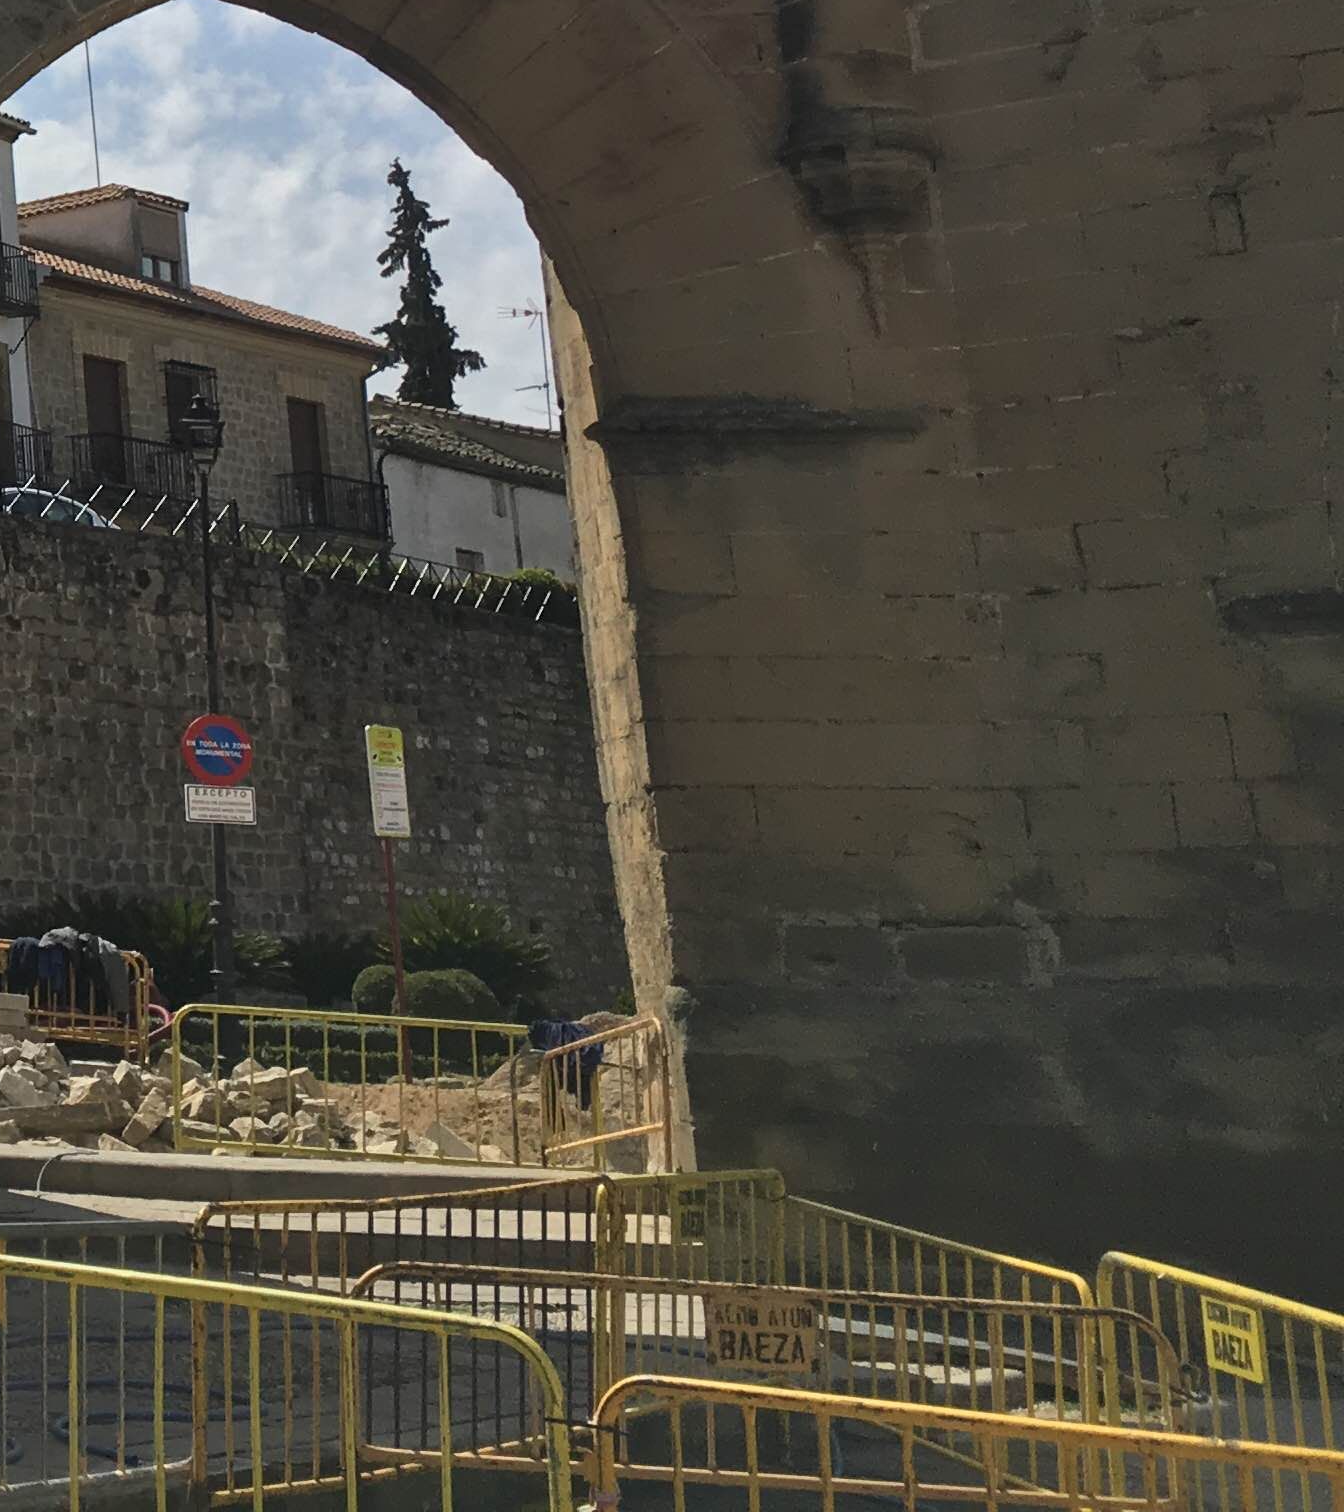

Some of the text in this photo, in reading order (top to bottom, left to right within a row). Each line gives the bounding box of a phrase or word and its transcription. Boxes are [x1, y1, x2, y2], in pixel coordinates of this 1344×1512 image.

[194, 788, 247, 798] EXCEPTO
[719, 1329, 806, 1364] BAEZA
[1211, 1329, 1255, 1373] BAEZA
